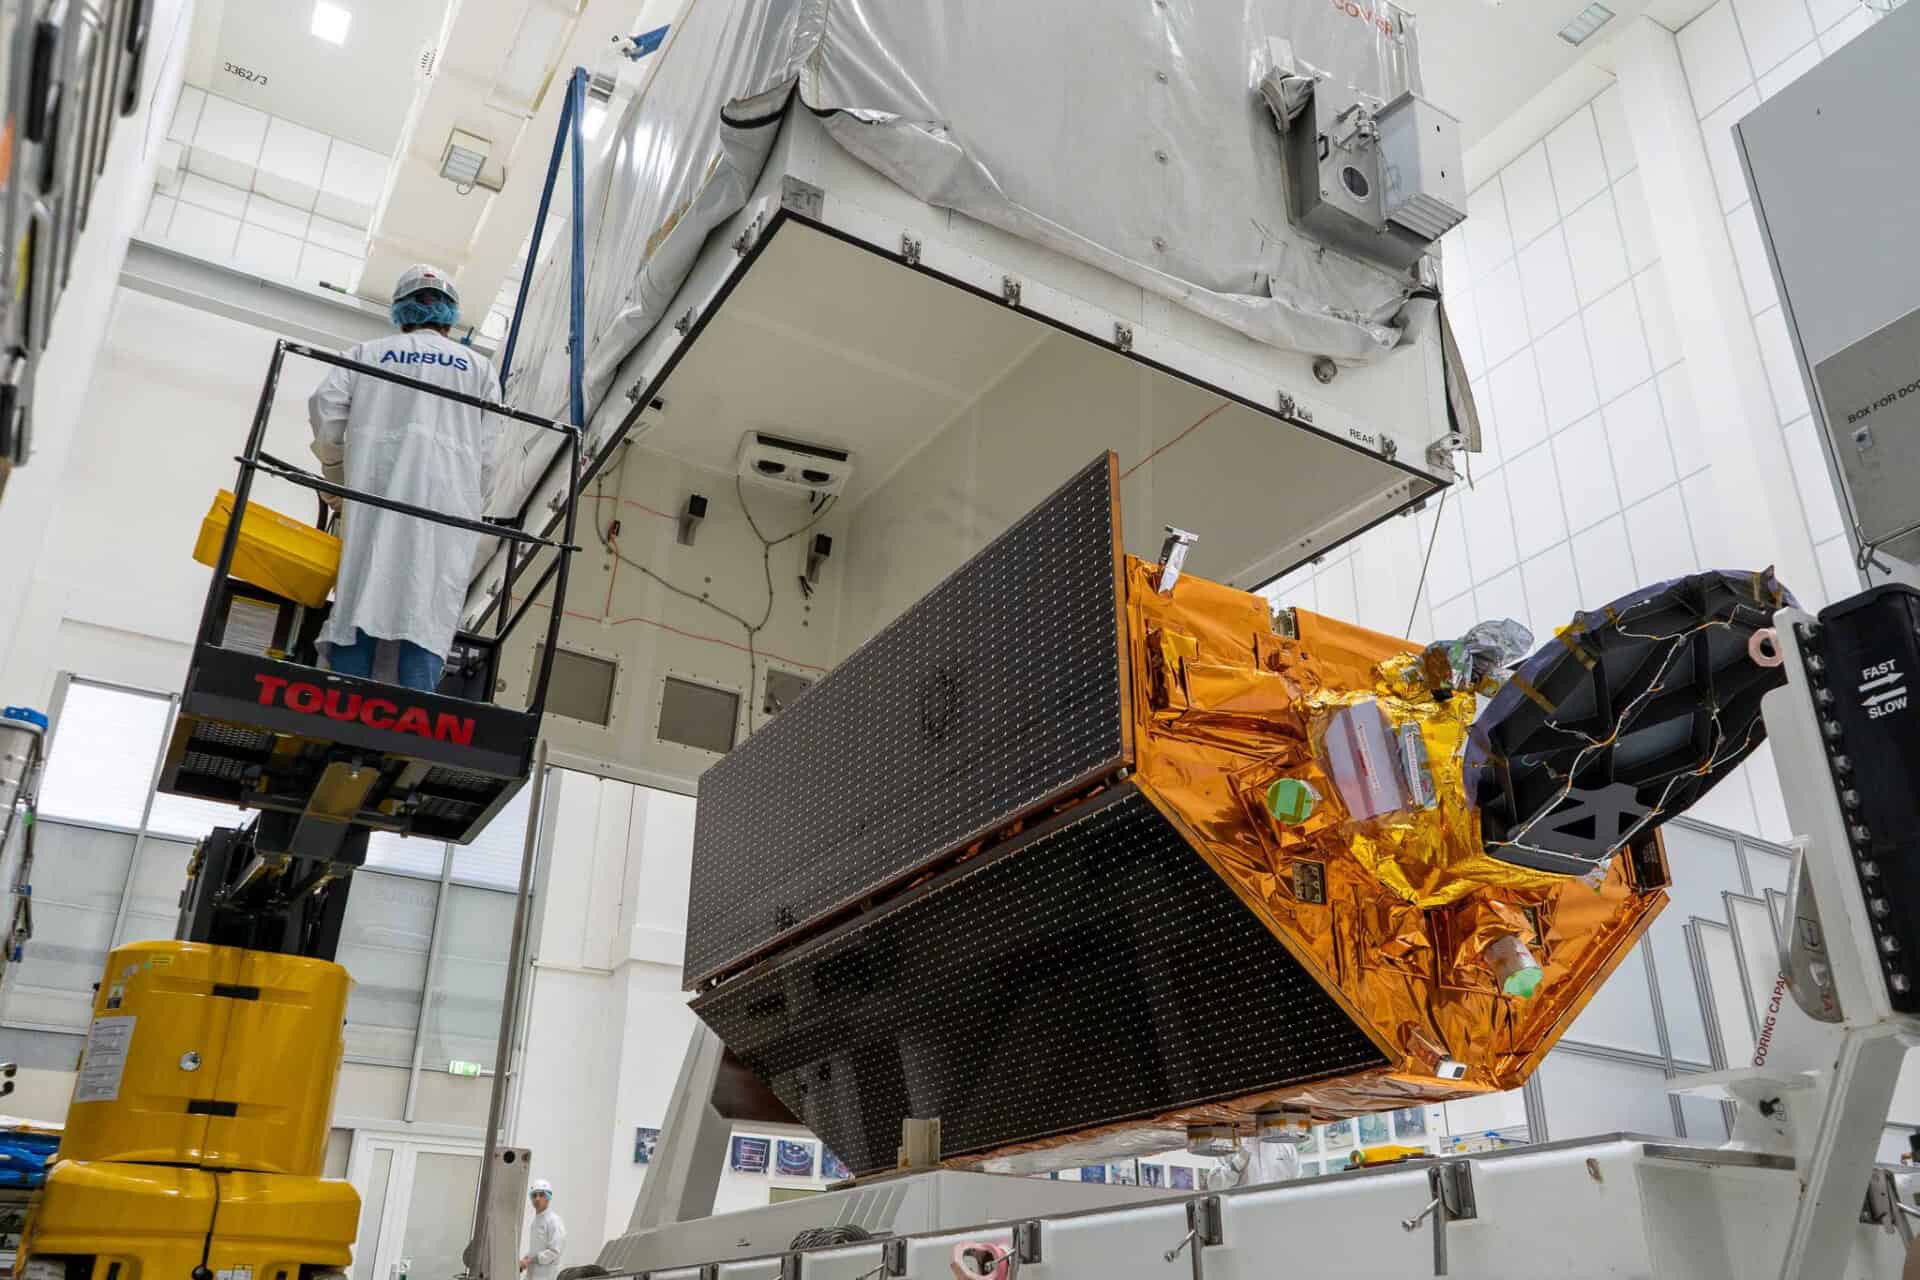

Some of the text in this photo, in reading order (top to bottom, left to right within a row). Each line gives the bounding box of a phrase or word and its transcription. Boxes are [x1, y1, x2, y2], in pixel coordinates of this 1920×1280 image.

[223, 61, 268, 86] 3362/3
[380, 350, 468, 371] AIRBUS
[1847, 406, 1871, 424] BOX
[1873, 392, 1896, 411] FOR
[1348, 428, 1375, 445] REAR
[1862, 658, 1897, 681] FAST
[255, 673, 476, 747] TOUCAN
[1867, 696, 1908, 719] SLOW
